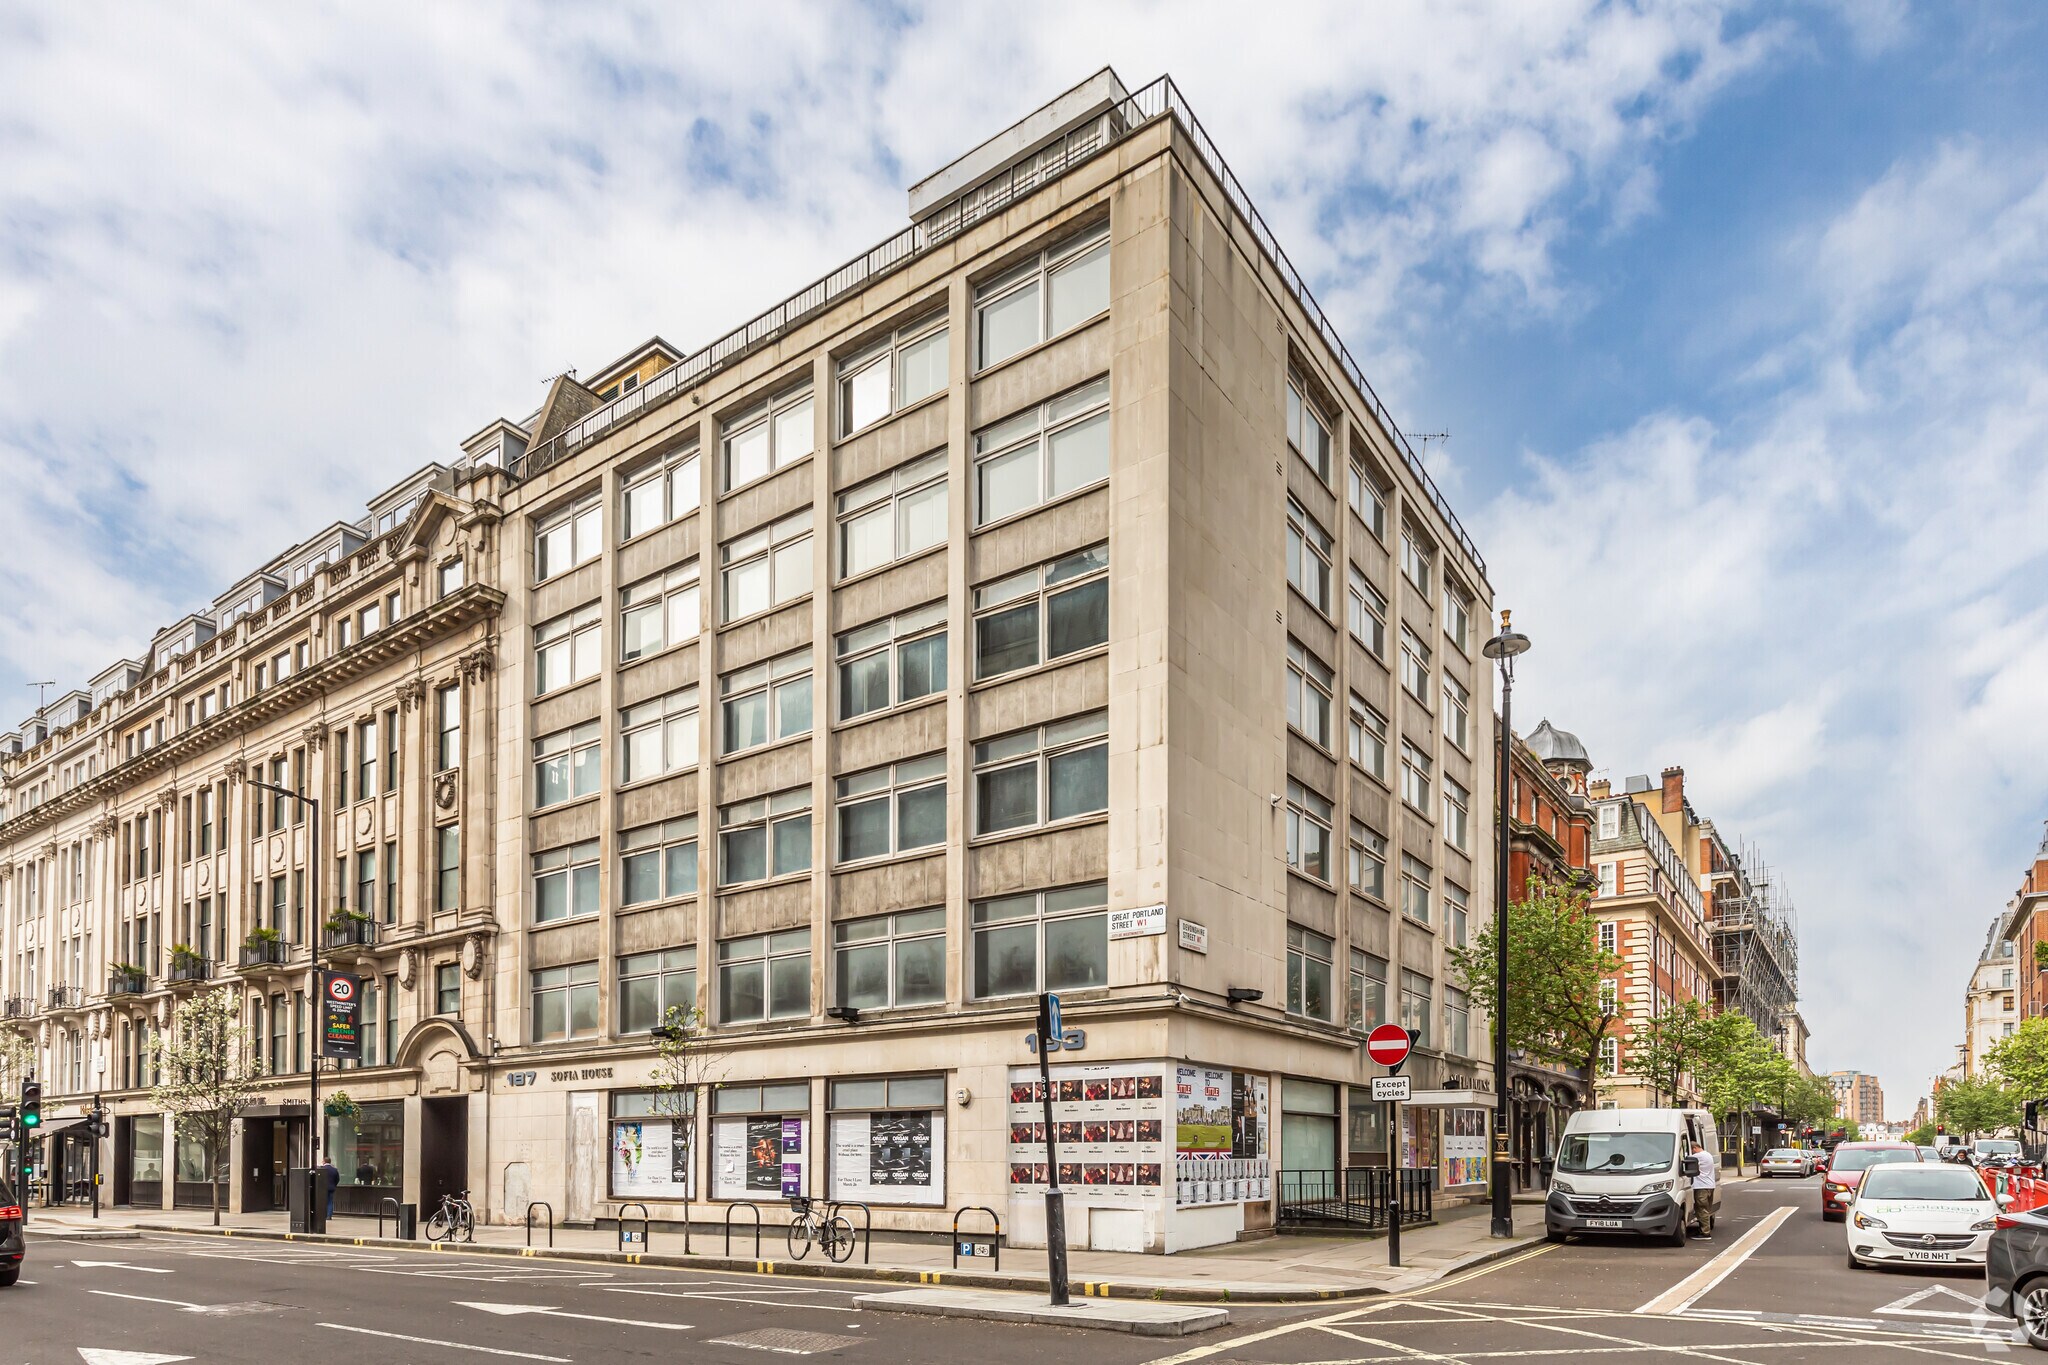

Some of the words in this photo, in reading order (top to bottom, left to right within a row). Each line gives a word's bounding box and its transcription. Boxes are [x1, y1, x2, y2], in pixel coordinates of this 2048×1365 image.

[1112, 913, 1129, 921] GREAT
[1133, 908, 1163, 918] PORTLAND
[1112, 921, 1133, 930] STREET
[1183, 923, 1205, 936] DEVONSHIRE
[1183, 932, 1196, 941] STREET
[334, 983, 349, 995] 20
[551, 1070, 578, 1082] SOFIA
[582, 1067, 613, 1080] HOUSE
[1177, 1068, 1196, 1077] WELCOME
[1205, 1072, 1223, 1080] WELCOME
[507, 1071, 537, 1087] 187
[1376, 1080, 1406, 1089] Except
[1177, 1085, 1191, 1094] LITTLE
[1206, 1088, 1219, 1096] LITTLE
[1377, 1089, 1405, 1098] cycles
[1904, 1204, 1980, 1213] Calabash
[963, 1243, 970, 1255] P
[1909, 1251, 1929, 1259] YY18
[1932, 1252, 1950, 1260] NHT
